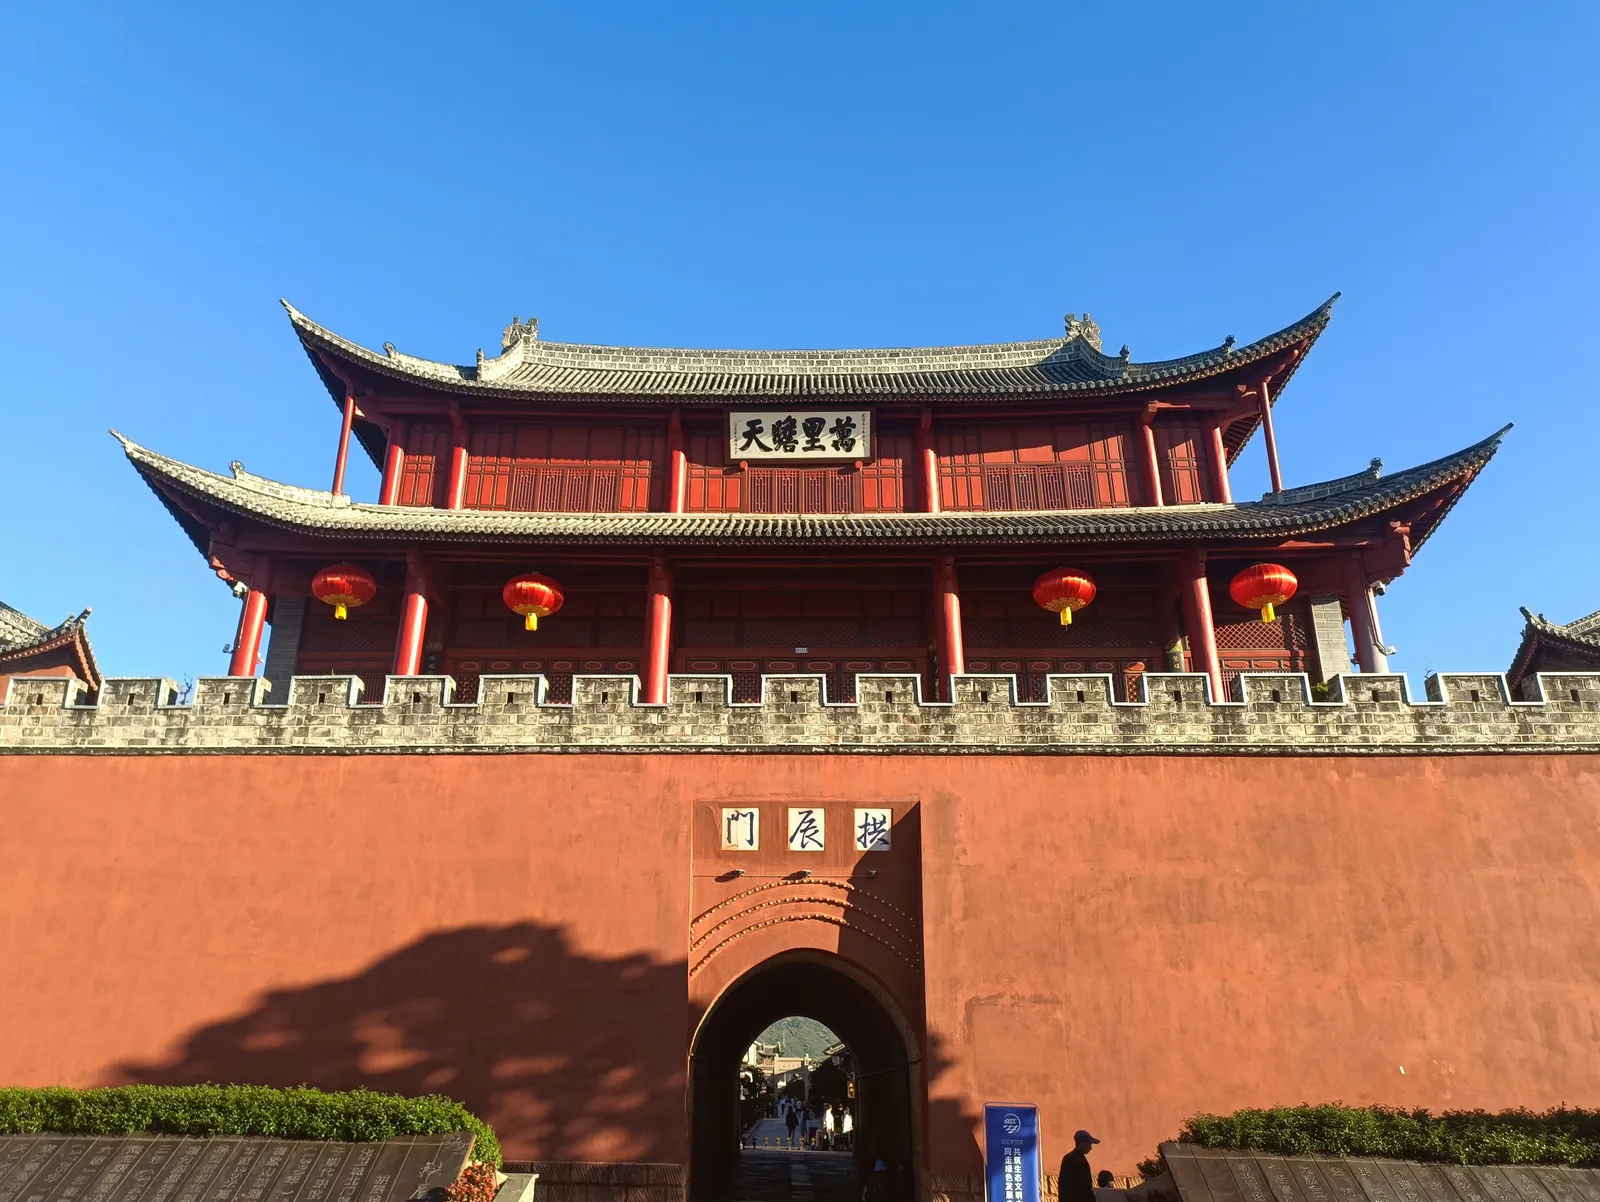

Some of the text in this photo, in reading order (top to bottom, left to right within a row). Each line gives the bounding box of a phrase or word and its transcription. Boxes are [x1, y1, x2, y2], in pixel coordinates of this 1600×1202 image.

[1004, 1147, 1014, 1202] 同走绿色发展
[1013, 1147, 1023, 1202] 共筑生态文明
